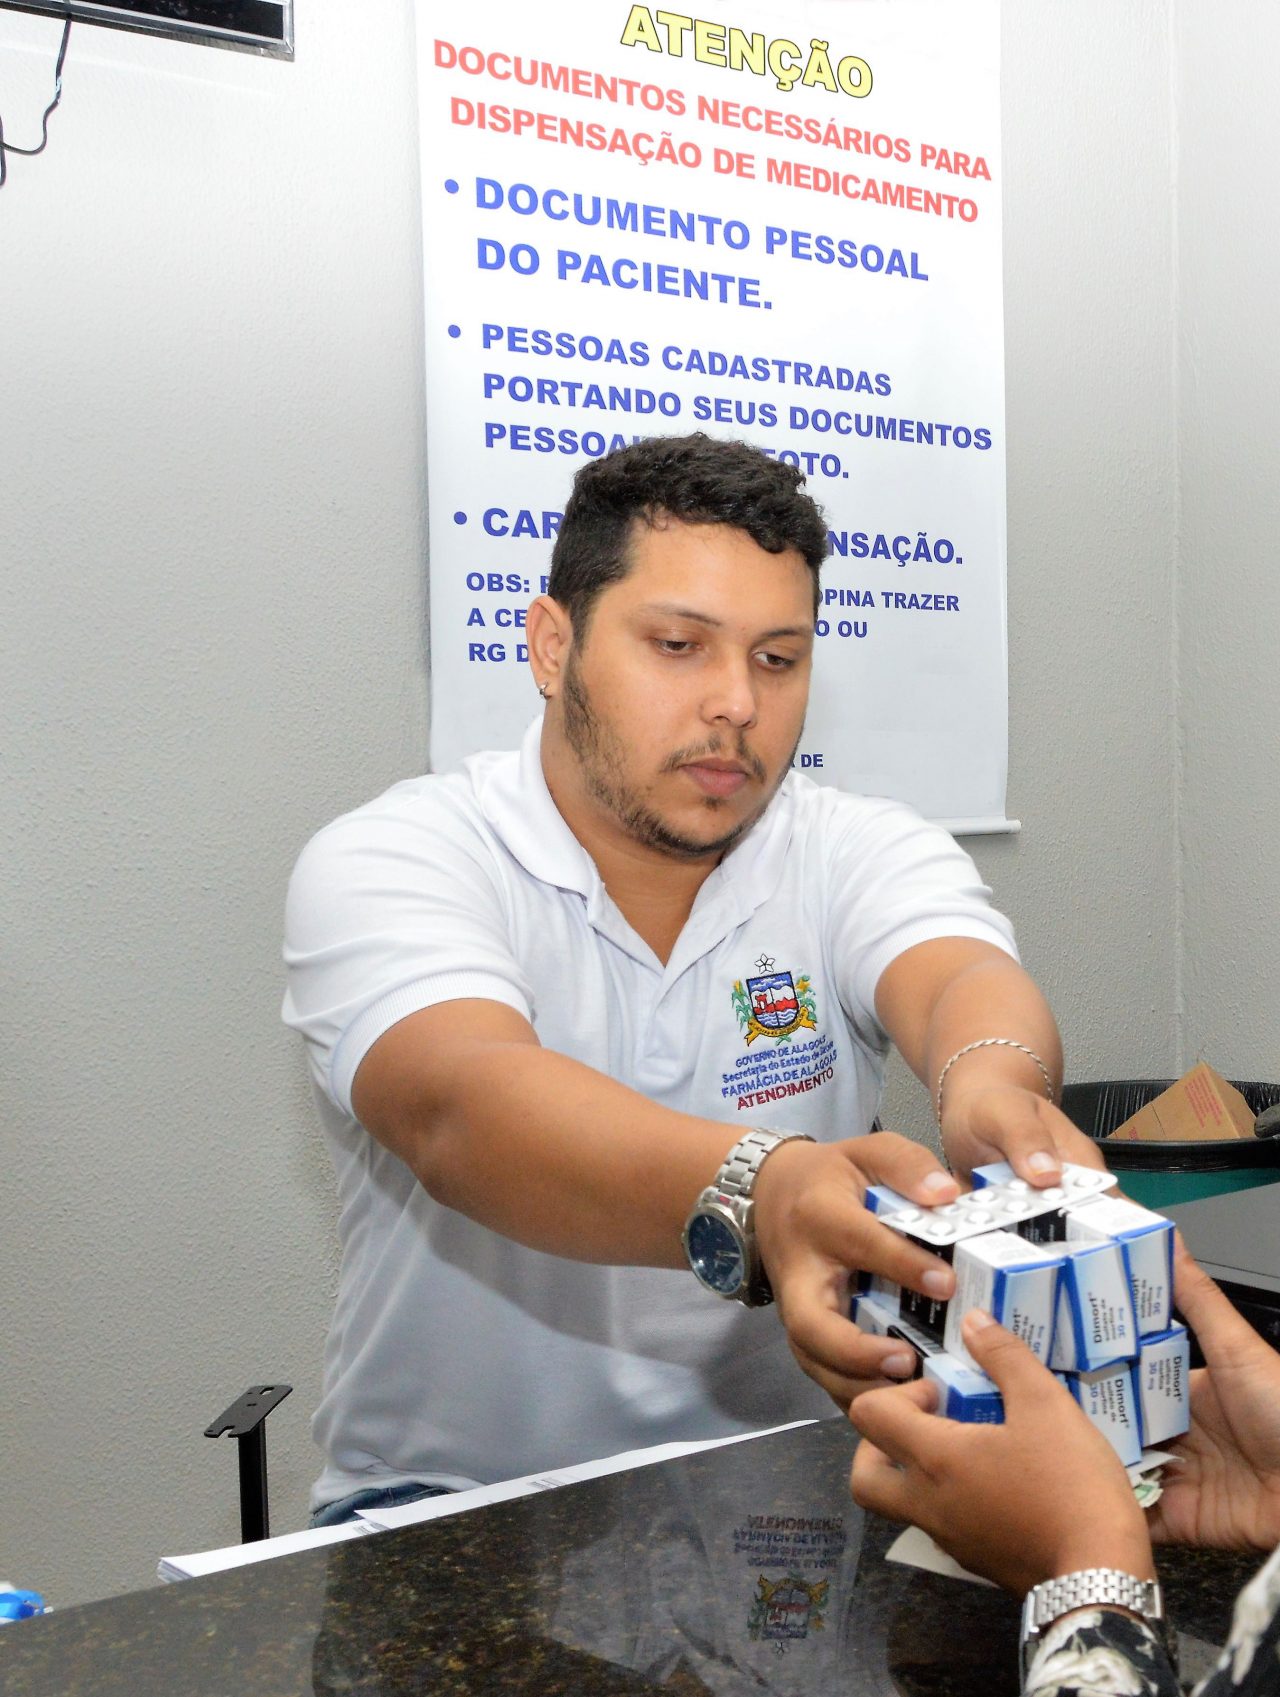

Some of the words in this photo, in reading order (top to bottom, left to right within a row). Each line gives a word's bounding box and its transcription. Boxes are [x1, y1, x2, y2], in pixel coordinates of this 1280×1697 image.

[621, 5, 872, 97] ATENÇÃO
[434, 40, 686, 115] DOCUMENTOS
[698, 96, 911, 163] NECESSÁRIOS
[921, 144, 991, 180] PARA
[451, 97, 702, 168] DISPENSAÇÃO
[714, 148, 755, 179] DE
[767, 158, 978, 222] MEDICAMENTO
[476, 177, 750, 250] DOCUMENTO
[766, 226, 928, 280] PESSOAL
[478, 238, 540, 275] DO
[557, 250, 772, 309] PACIENTE.
[482, 324, 650, 366] PESSOAS
[662, 346, 891, 396] CADASTRADAS
[484, 373, 681, 416] PORTANDO
[694, 396, 777, 427] SEUS
[790, 406, 992, 450] DOCUMENTOS
[466, 572, 529, 592] OBS:
[819, 588, 874, 606] PINA
[882, 592, 958, 610] TRAZER
[467, 608, 485, 627] A
[838, 620, 867, 638] OU
[469, 643, 506, 662] RG
[801, 754, 823, 767] DE
[721, 1074, 781, 1098] FARMÁCIA
[783, 1069, 800, 1082] DE
[800, 1049, 838, 1078] ALAGOAS
[722, 1064, 767, 1084] Secretaria
[781, 1055, 811, 1068] Estado
[735, 1049, 776, 1068] GOVERNO
[778, 1047, 790, 1058] DE
[791, 1034, 826, 1054] ALAGOAS
[737, 1066, 834, 1111] ATENDIMENTO
